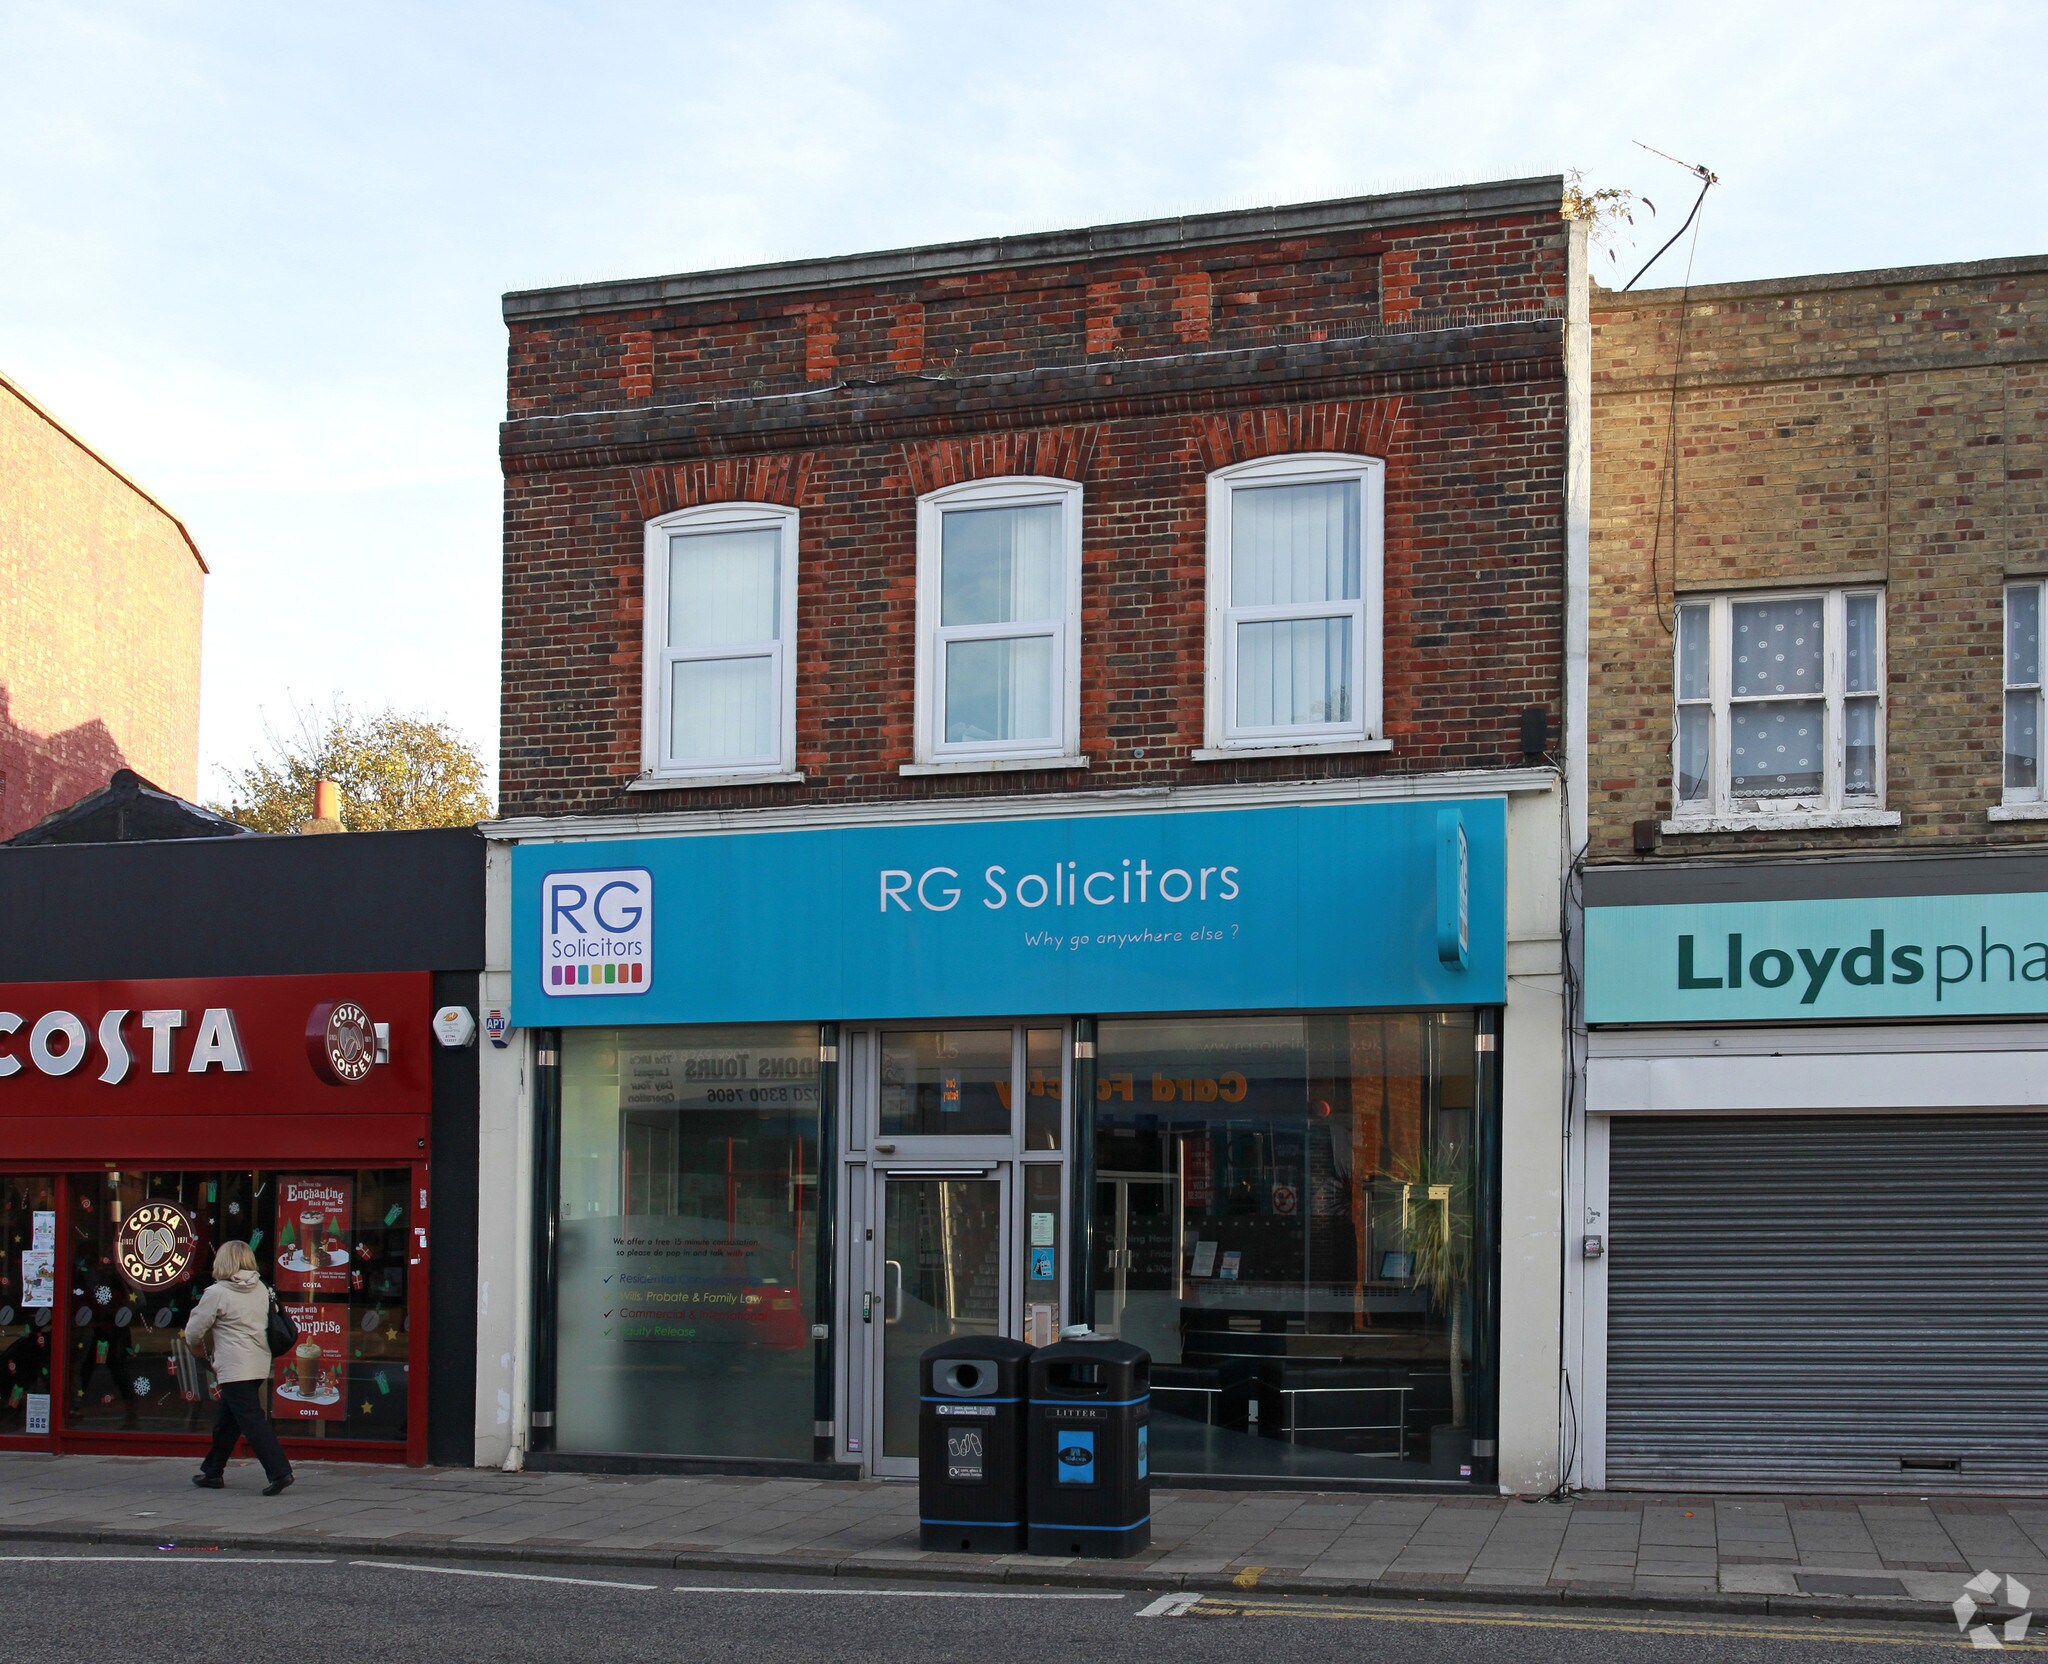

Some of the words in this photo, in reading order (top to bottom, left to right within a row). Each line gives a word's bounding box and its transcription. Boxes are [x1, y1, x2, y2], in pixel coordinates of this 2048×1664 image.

[880, 866, 961, 912] RG
[983, 859, 1240, 910] Solicitors
[552, 881, 642, 934] RG
[1024, 931, 1063, 951] Why
[1070, 934, 1090, 951] go
[1096, 928, 1182, 949] anywhere
[1190, 926, 1223, 941] else
[1230, 924, 1240, 940] ?
[552, 938, 642, 958] Solicitors
[333, 1006, 366, 1029] COSTA
[486, 1018, 505, 1029] APT
[332, 1049, 371, 1077] COFFEE
[287, 1184, 344, 1204] Enchanting
[129, 1207, 180, 1231] COSTA
[626, 1238, 645, 1246] offer
[674, 1238, 682, 1246] 15
[685, 1238, 710, 1246] minute
[1105, 1234, 1145, 1245] Oping
[627, 1250, 651, 1258] please
[124, 1253, 185, 1282] COFFEE
[620, 1273, 677, 1284] Residential
[646, 1292, 689, 1302] Probate
[692, 1292, 700, 1302] &
[703, 1292, 738, 1305] Family
[740, 1293, 763, 1304] Law
[284, 1305, 304, 1314] Topped
[305, 1305, 317, 1313] with
[620, 1308, 685, 1320] Commercial
[689, 1309, 696, 1320] &
[654, 1325, 696, 1337] Release
[1056, 1409, 1096, 1417] LITTER
